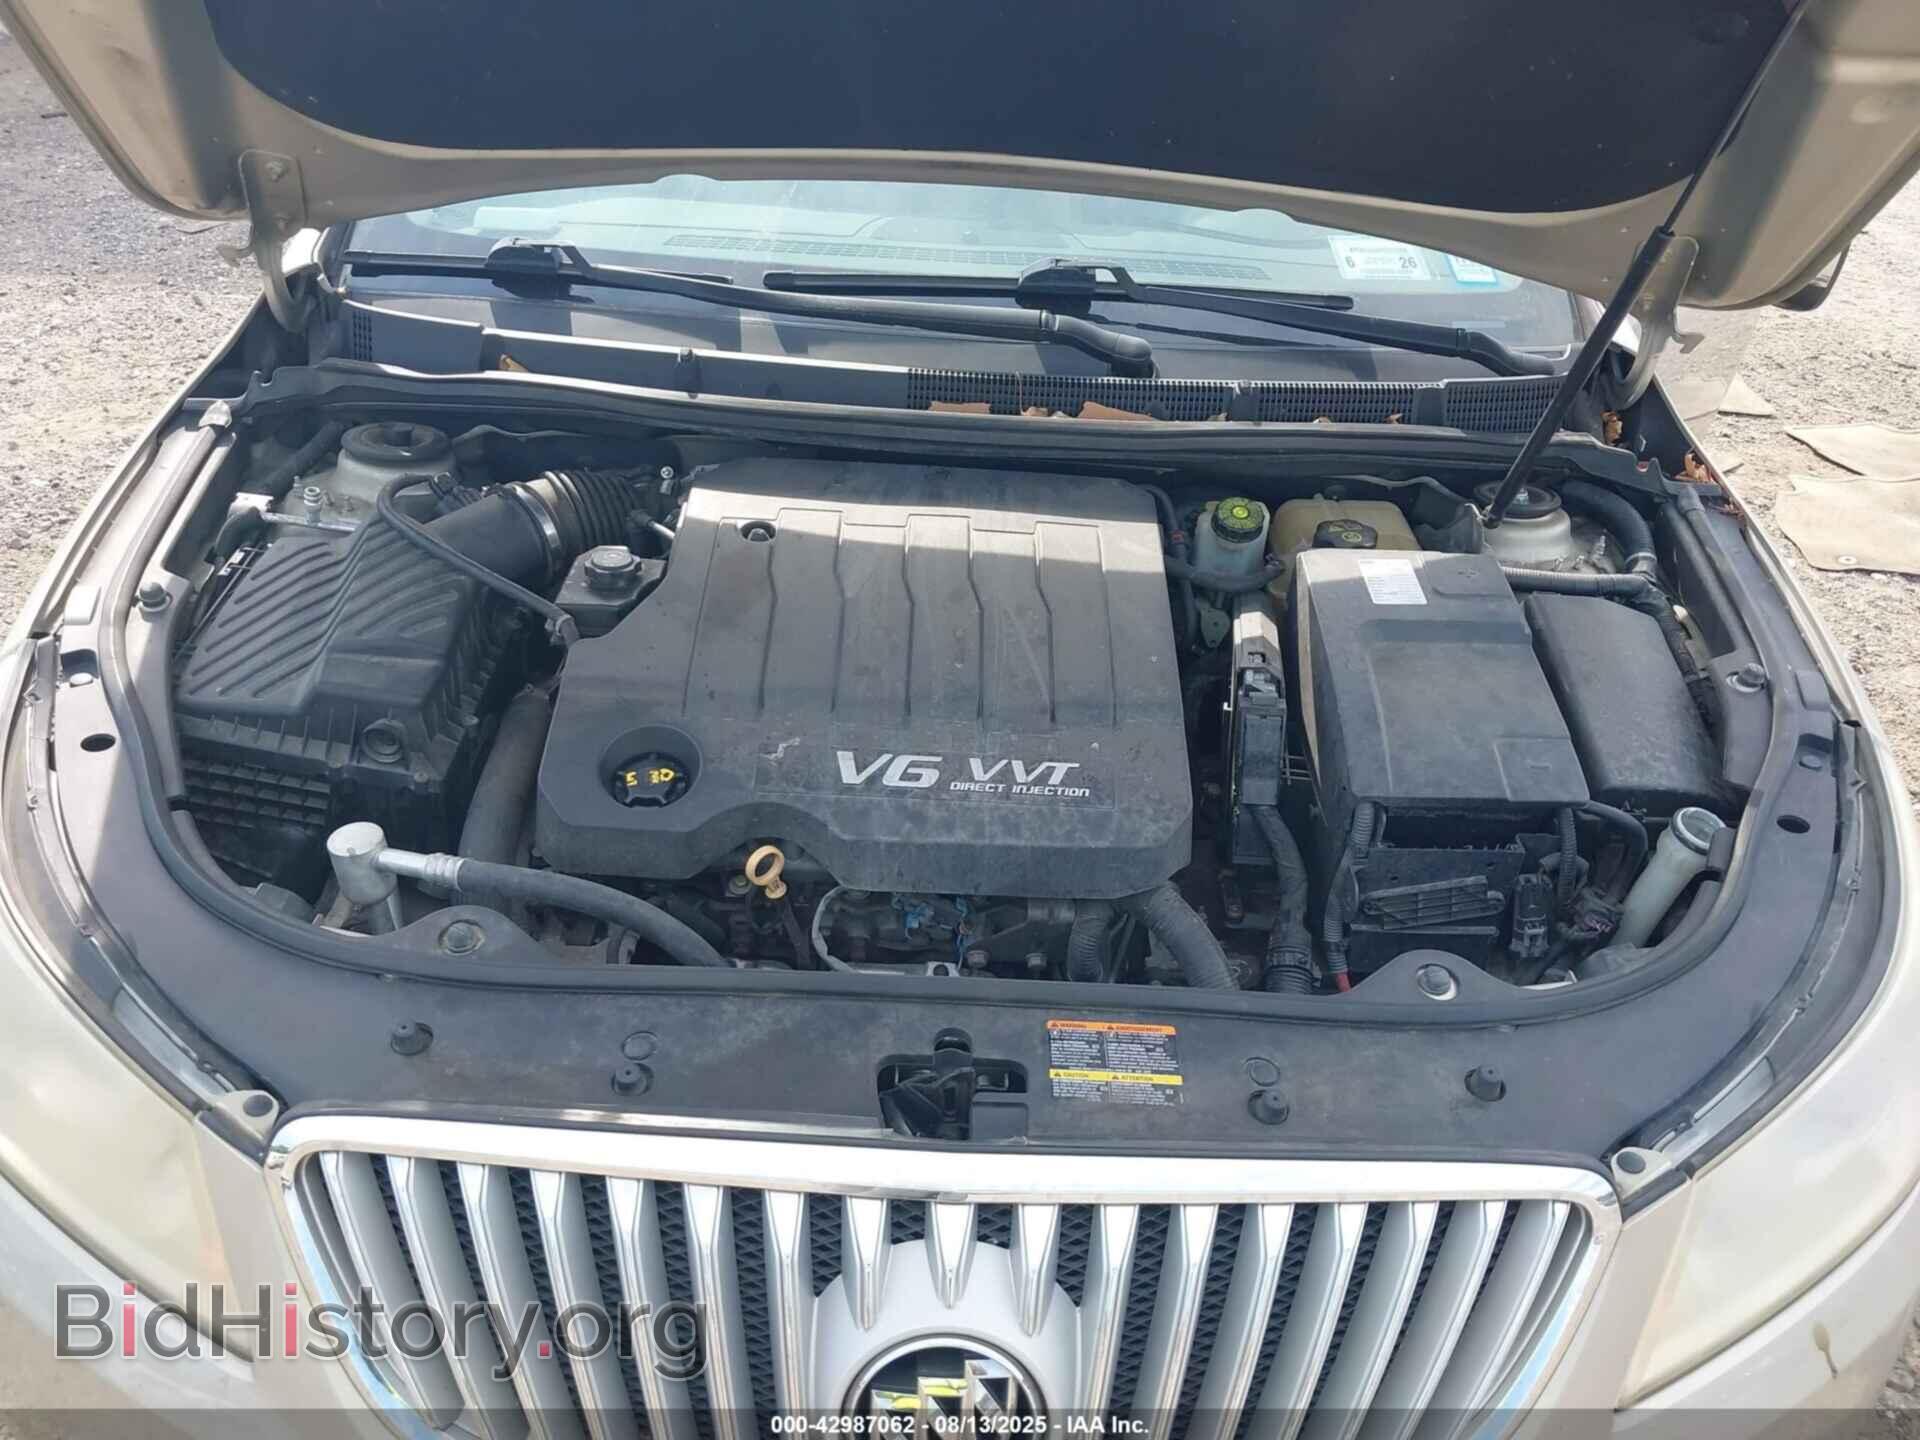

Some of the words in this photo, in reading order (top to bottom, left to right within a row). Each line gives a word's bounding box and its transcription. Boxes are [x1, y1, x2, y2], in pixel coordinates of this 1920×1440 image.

[1399, 256, 1417, 269] 26
[836, 751, 943, 788] V6
[968, 757, 1080, 785] VVT
[950, 782, 1006, 793] DIRECT
[1012, 785, 1090, 797] INJECTION
